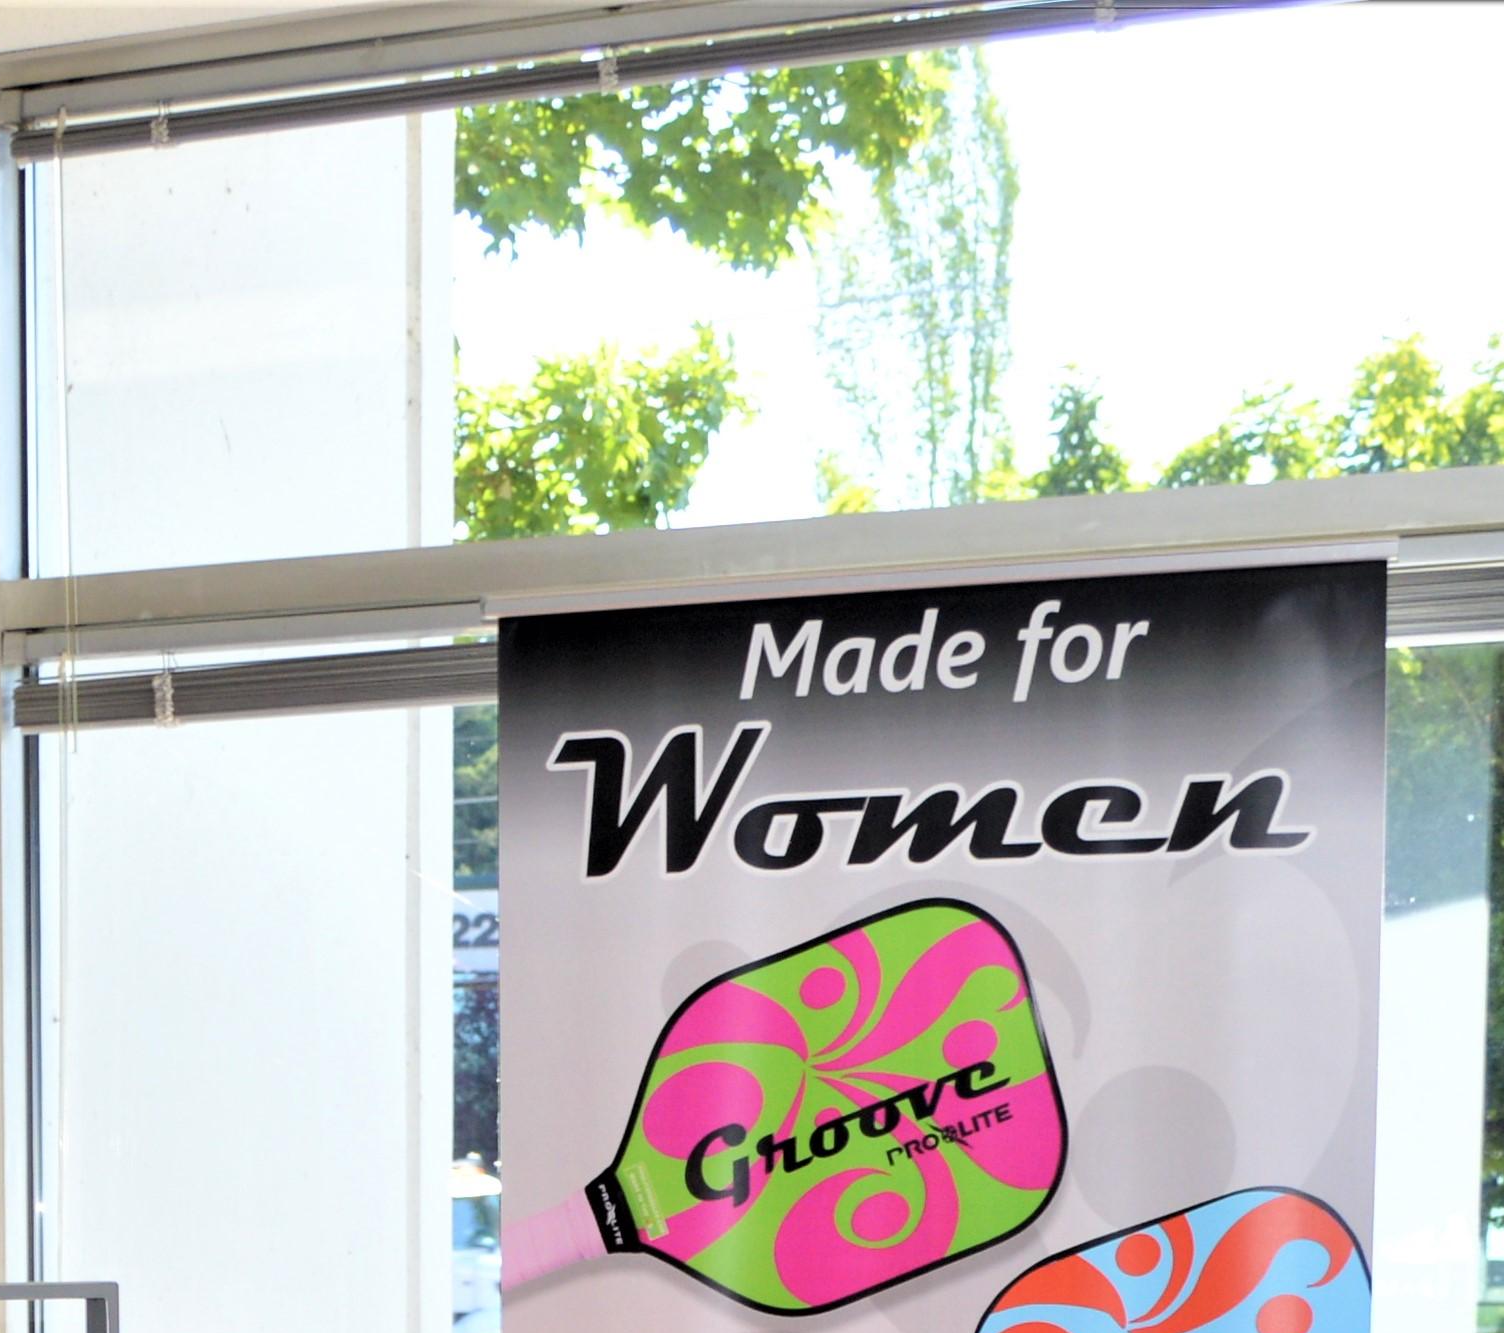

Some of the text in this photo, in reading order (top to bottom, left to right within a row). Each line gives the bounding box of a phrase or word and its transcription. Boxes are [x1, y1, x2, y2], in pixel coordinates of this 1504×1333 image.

[740, 601, 1149, 702] Made for
[546, 720, 1313, 880] Women
[684, 1060, 1011, 1207] Groove
